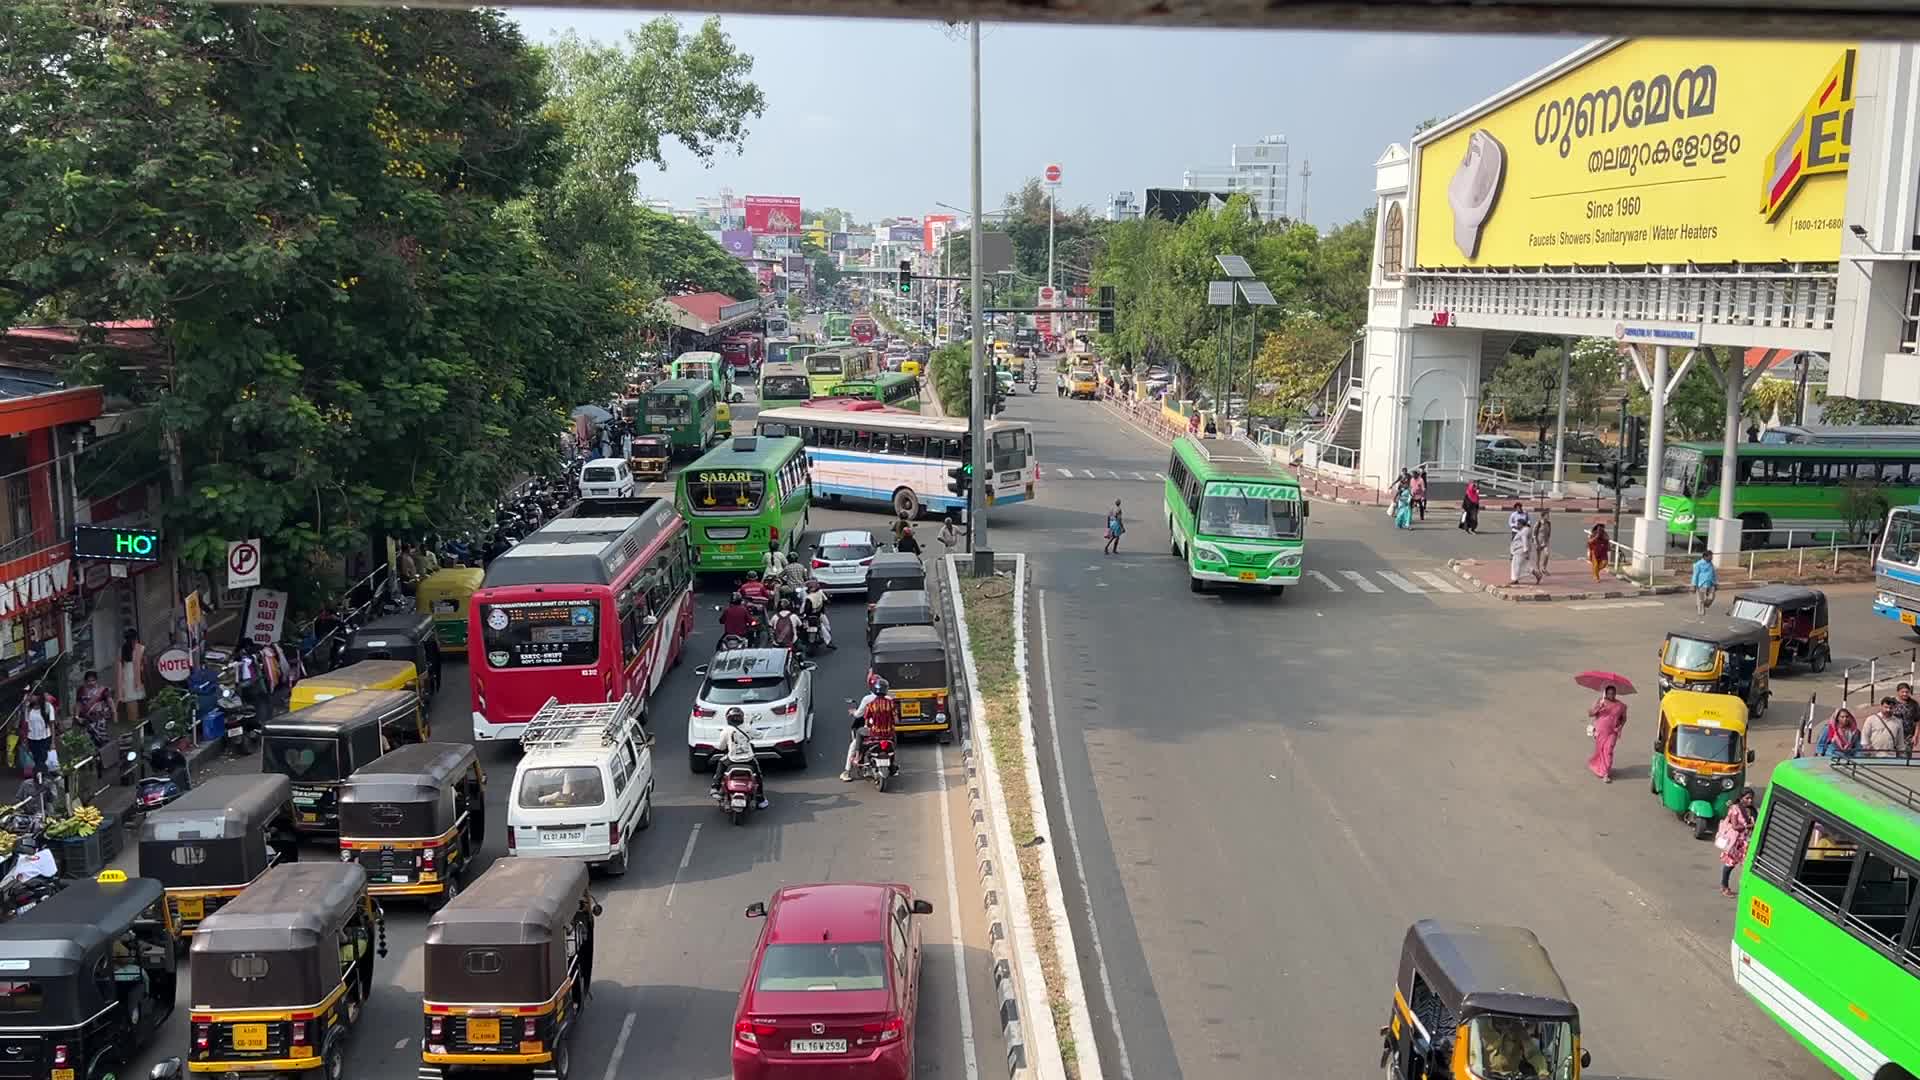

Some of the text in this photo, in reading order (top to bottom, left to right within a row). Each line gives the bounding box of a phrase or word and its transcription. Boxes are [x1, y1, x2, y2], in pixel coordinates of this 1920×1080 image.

[1534, 64, 1718, 159] ഗുണമേന്മ
[1587, 130, 1741, 177] തലമുറകളോളം
[1585, 196, 1641, 220] Since 1960
[1528, 224, 1718, 247] Faucets Showers Sanitaryware Water Heaters
[700, 472, 752, 482] SABARI
[1209, 484, 1298, 500] ATTUKAL
[159, 659, 192, 672] HOTEL
[825, 1041, 846, 1051] 2594
